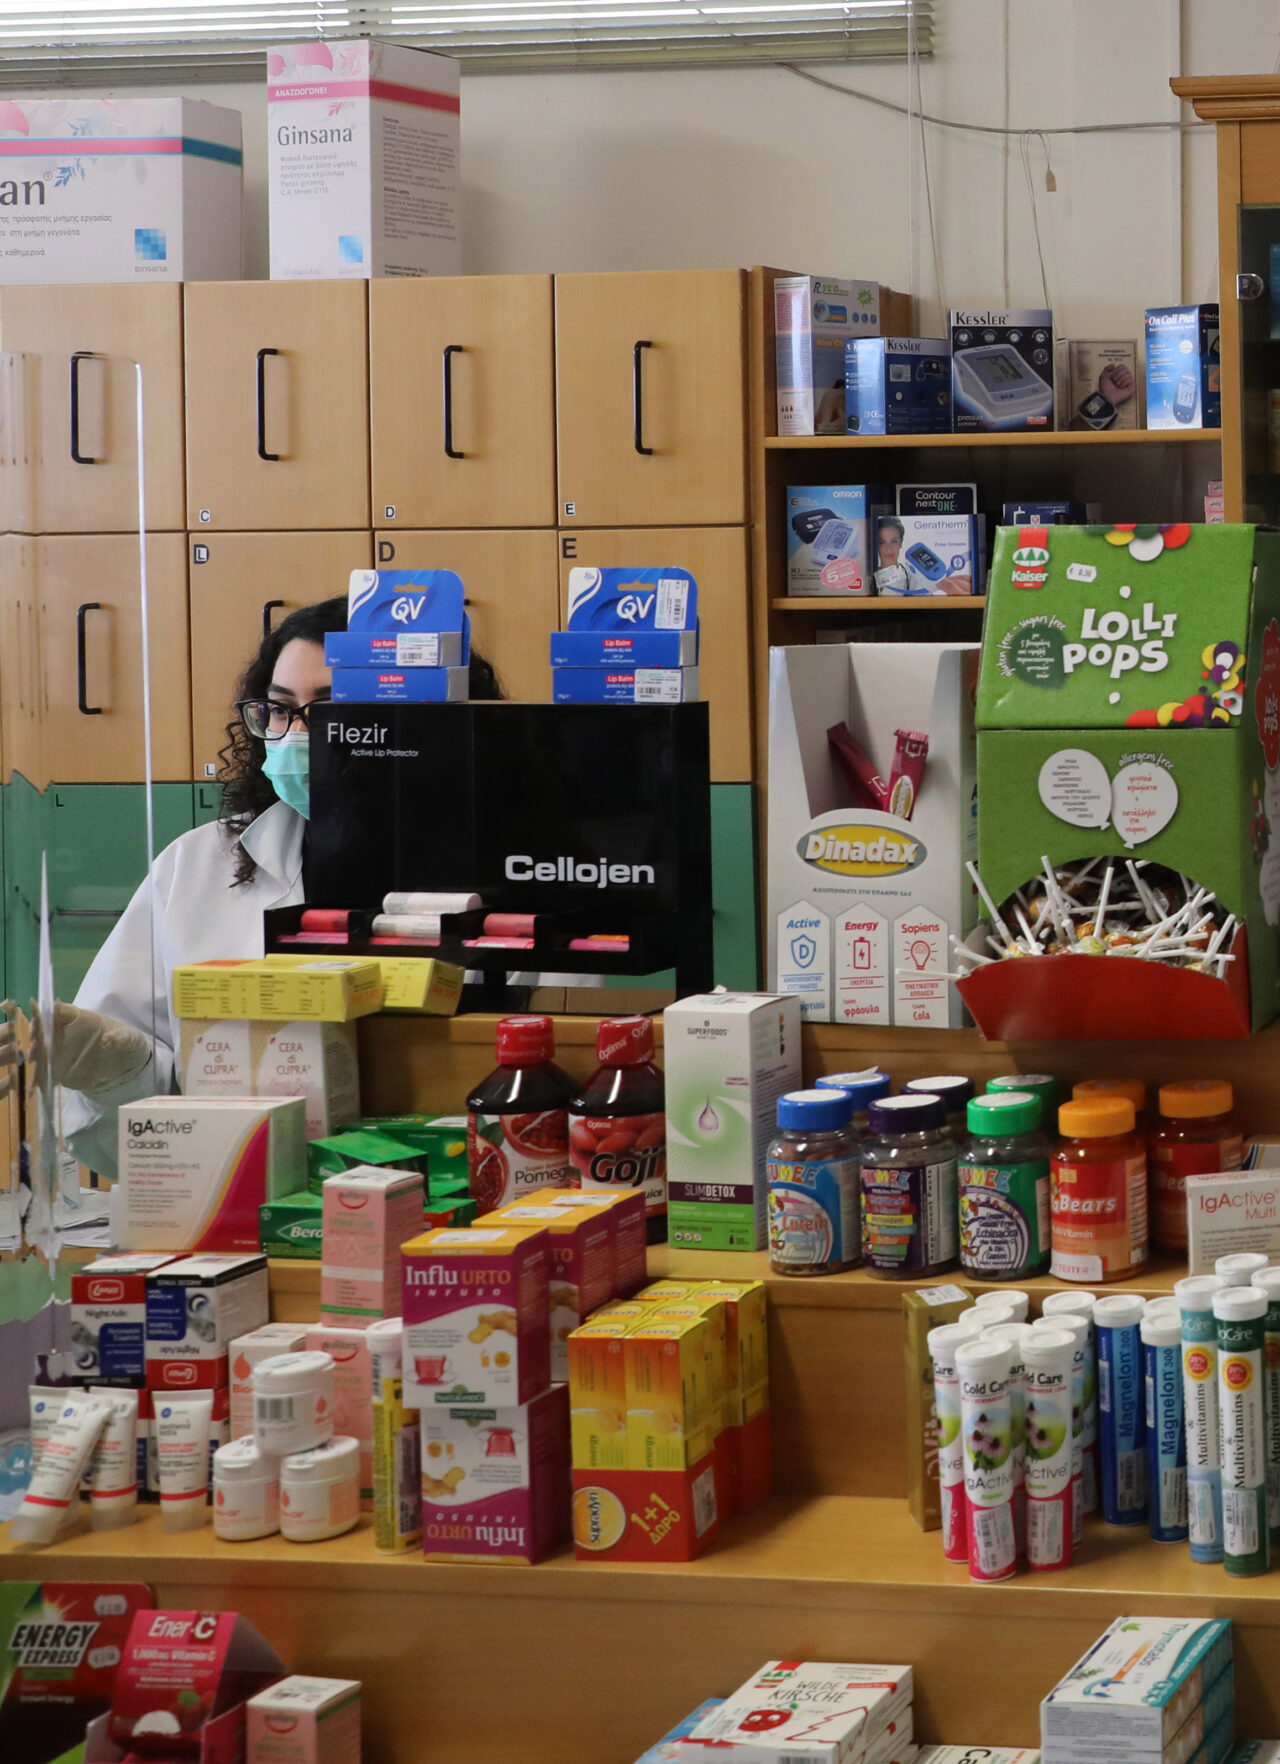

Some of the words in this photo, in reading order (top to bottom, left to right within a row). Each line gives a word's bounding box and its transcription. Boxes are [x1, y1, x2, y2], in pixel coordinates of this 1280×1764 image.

[277, 126, 354, 147] Ginsana
[1148, 315, 1161, 327] On
[1161, 314, 1177, 326] Call
[1179, 312, 1196, 324] Plus
[915, 490, 956, 501] Contour
[385, 506, 395, 518] D
[915, 500, 937, 509] next
[937, 500, 956, 512] ONE
[914, 519, 968, 531] Geratherm
[378, 541, 395, 562] D
[562, 538, 577, 559] E
[1012, 570, 1049, 583] Kaiser
[391, 595, 426, 624] QV
[616, 593, 655, 624] QV
[1080, 602, 1178, 641] LOLLI
[605, 639, 614, 648] Lip
[614, 639, 630, 647] Balm
[1062, 640, 1169, 679] POPS
[380, 675, 389, 683] Lip
[327, 723, 388, 744] Flezir
[350, 748, 374, 757] Active
[375, 748, 385, 759] Lip
[386, 748, 419, 757] Protector
[805, 834, 919, 865] Dinadax
[505, 854, 655, 889] Cellojen
[786, 918, 821, 928] Active
[844, 921, 879, 931] Energy
[902, 922, 940, 934] Sapiens
[844, 1005, 880, 1017] φράουλα
[913, 1010, 931, 1021] Cola
[687, 1027, 728, 1036] SUPERFOODS
[206, 1042, 231, 1052] CERA
[278, 1042, 304, 1052] CERA
[214, 1053, 223, 1063] di
[287, 1053, 296, 1063] di
[203, 1065, 235, 1075] CUPRA
[276, 1065, 308, 1075] CUPRA
[128, 1119, 193, 1138] IgActive
[588, 1120, 611, 1130] Optima
[591, 1153, 660, 1186] Goji
[685, 1185, 736, 1198] SLIMDETOX
[1245, 1207, 1277, 1221] Multi
[405, 1265, 458, 1286] Influ
[461, 1269, 511, 1286] URTO
[414, 1288, 502, 1297] INFUSO
[1120, 1330, 1130, 1351] 300
[1165, 1347, 1175, 1369] 300
[1037, 1372, 1064, 1384] Care
[963, 1381, 987, 1396] Cold
[1118, 1352, 1135, 1439] Magnelon
[1160, 1371, 1177, 1456] Magnelon
[1197, 1382, 1209, 1467] Multivitamins
[1233, 1392, 1244, 1490] Multivitamins
[148, 1615, 217, 1640] Ener-C
[11, 1623, 92, 1649] ENERGY
[23, 1649, 80, 1666] EXPRESS
[796, 1681, 838, 1691] WILDE
[768, 1690, 849, 1703] KIRSCHE
